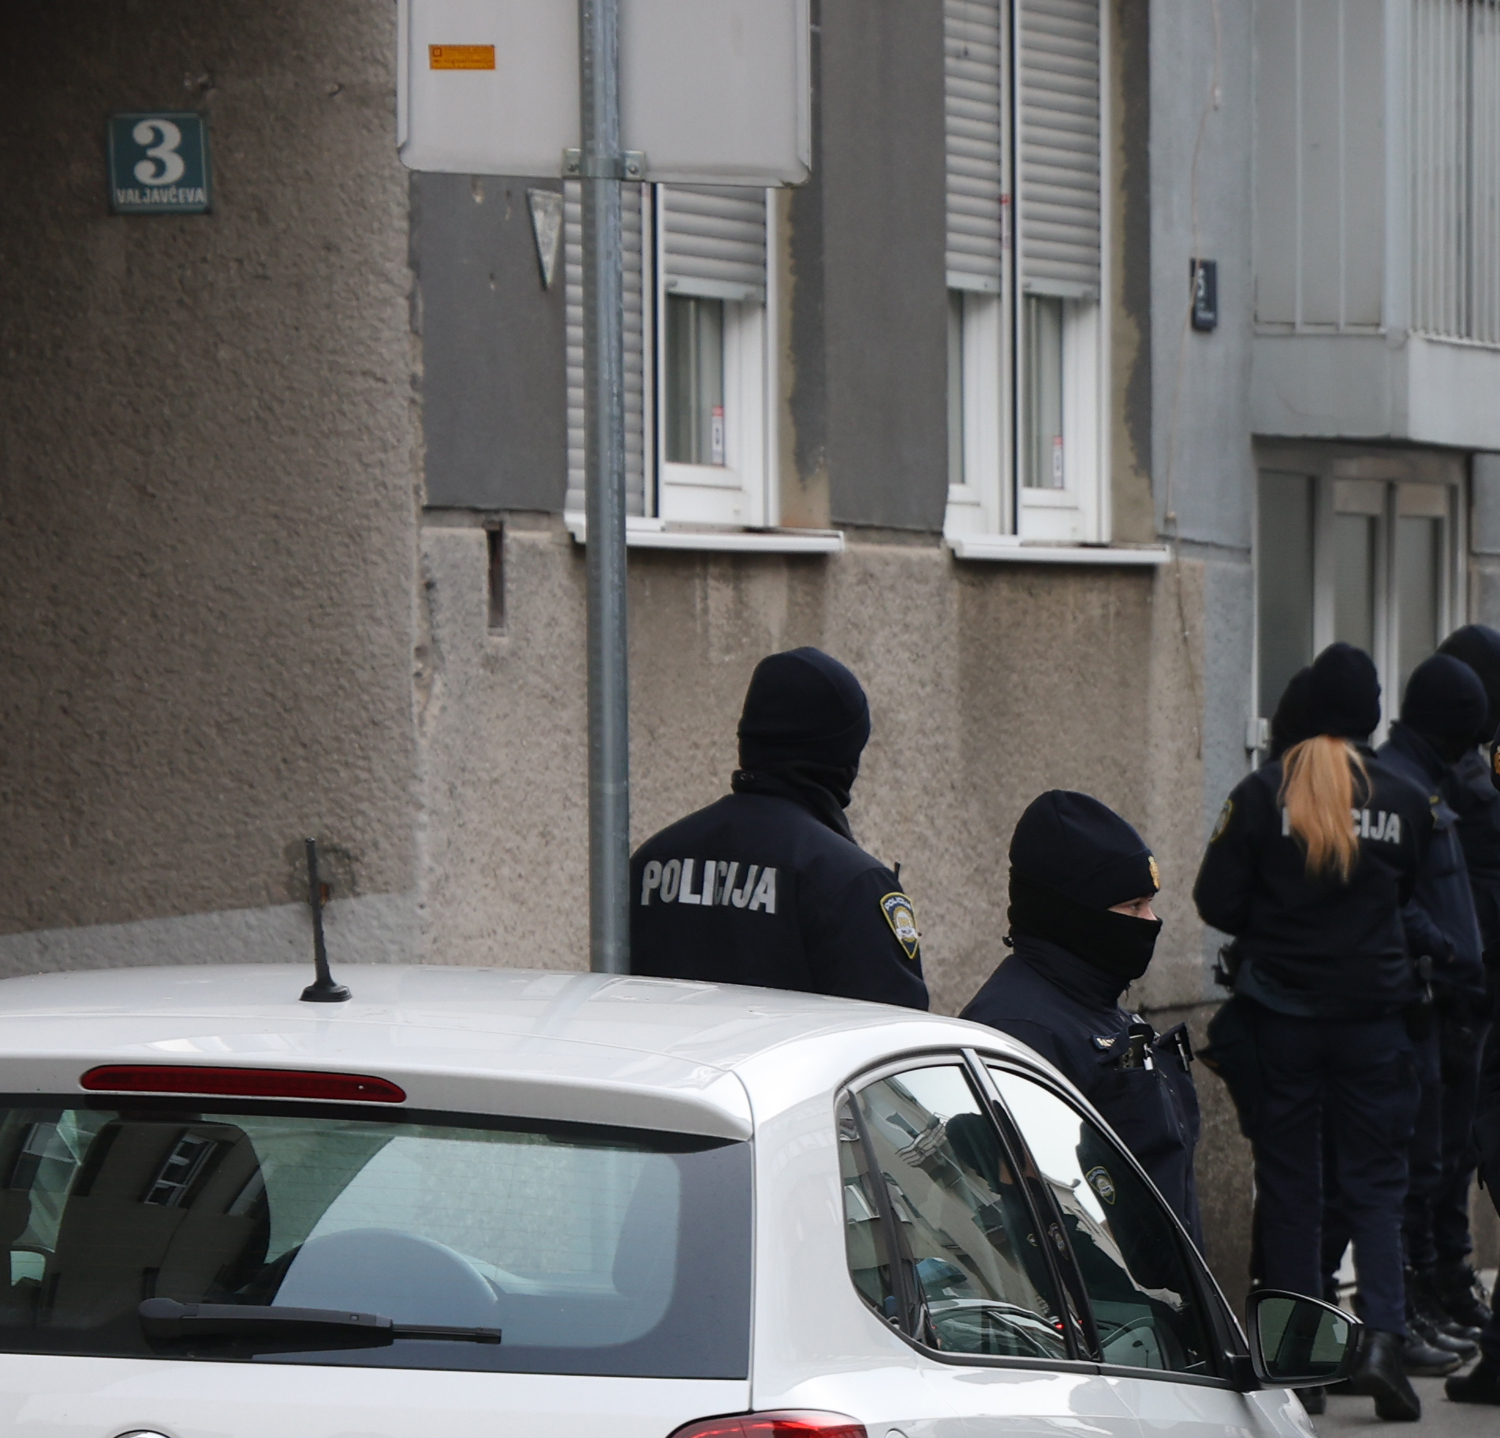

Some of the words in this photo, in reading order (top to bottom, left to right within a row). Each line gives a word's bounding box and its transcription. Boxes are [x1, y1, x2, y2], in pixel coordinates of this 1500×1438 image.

[132, 119, 185, 187] 3
[117, 186, 207, 204] VALJAVČEVA
[641, 858, 777, 914] POLICIJA
